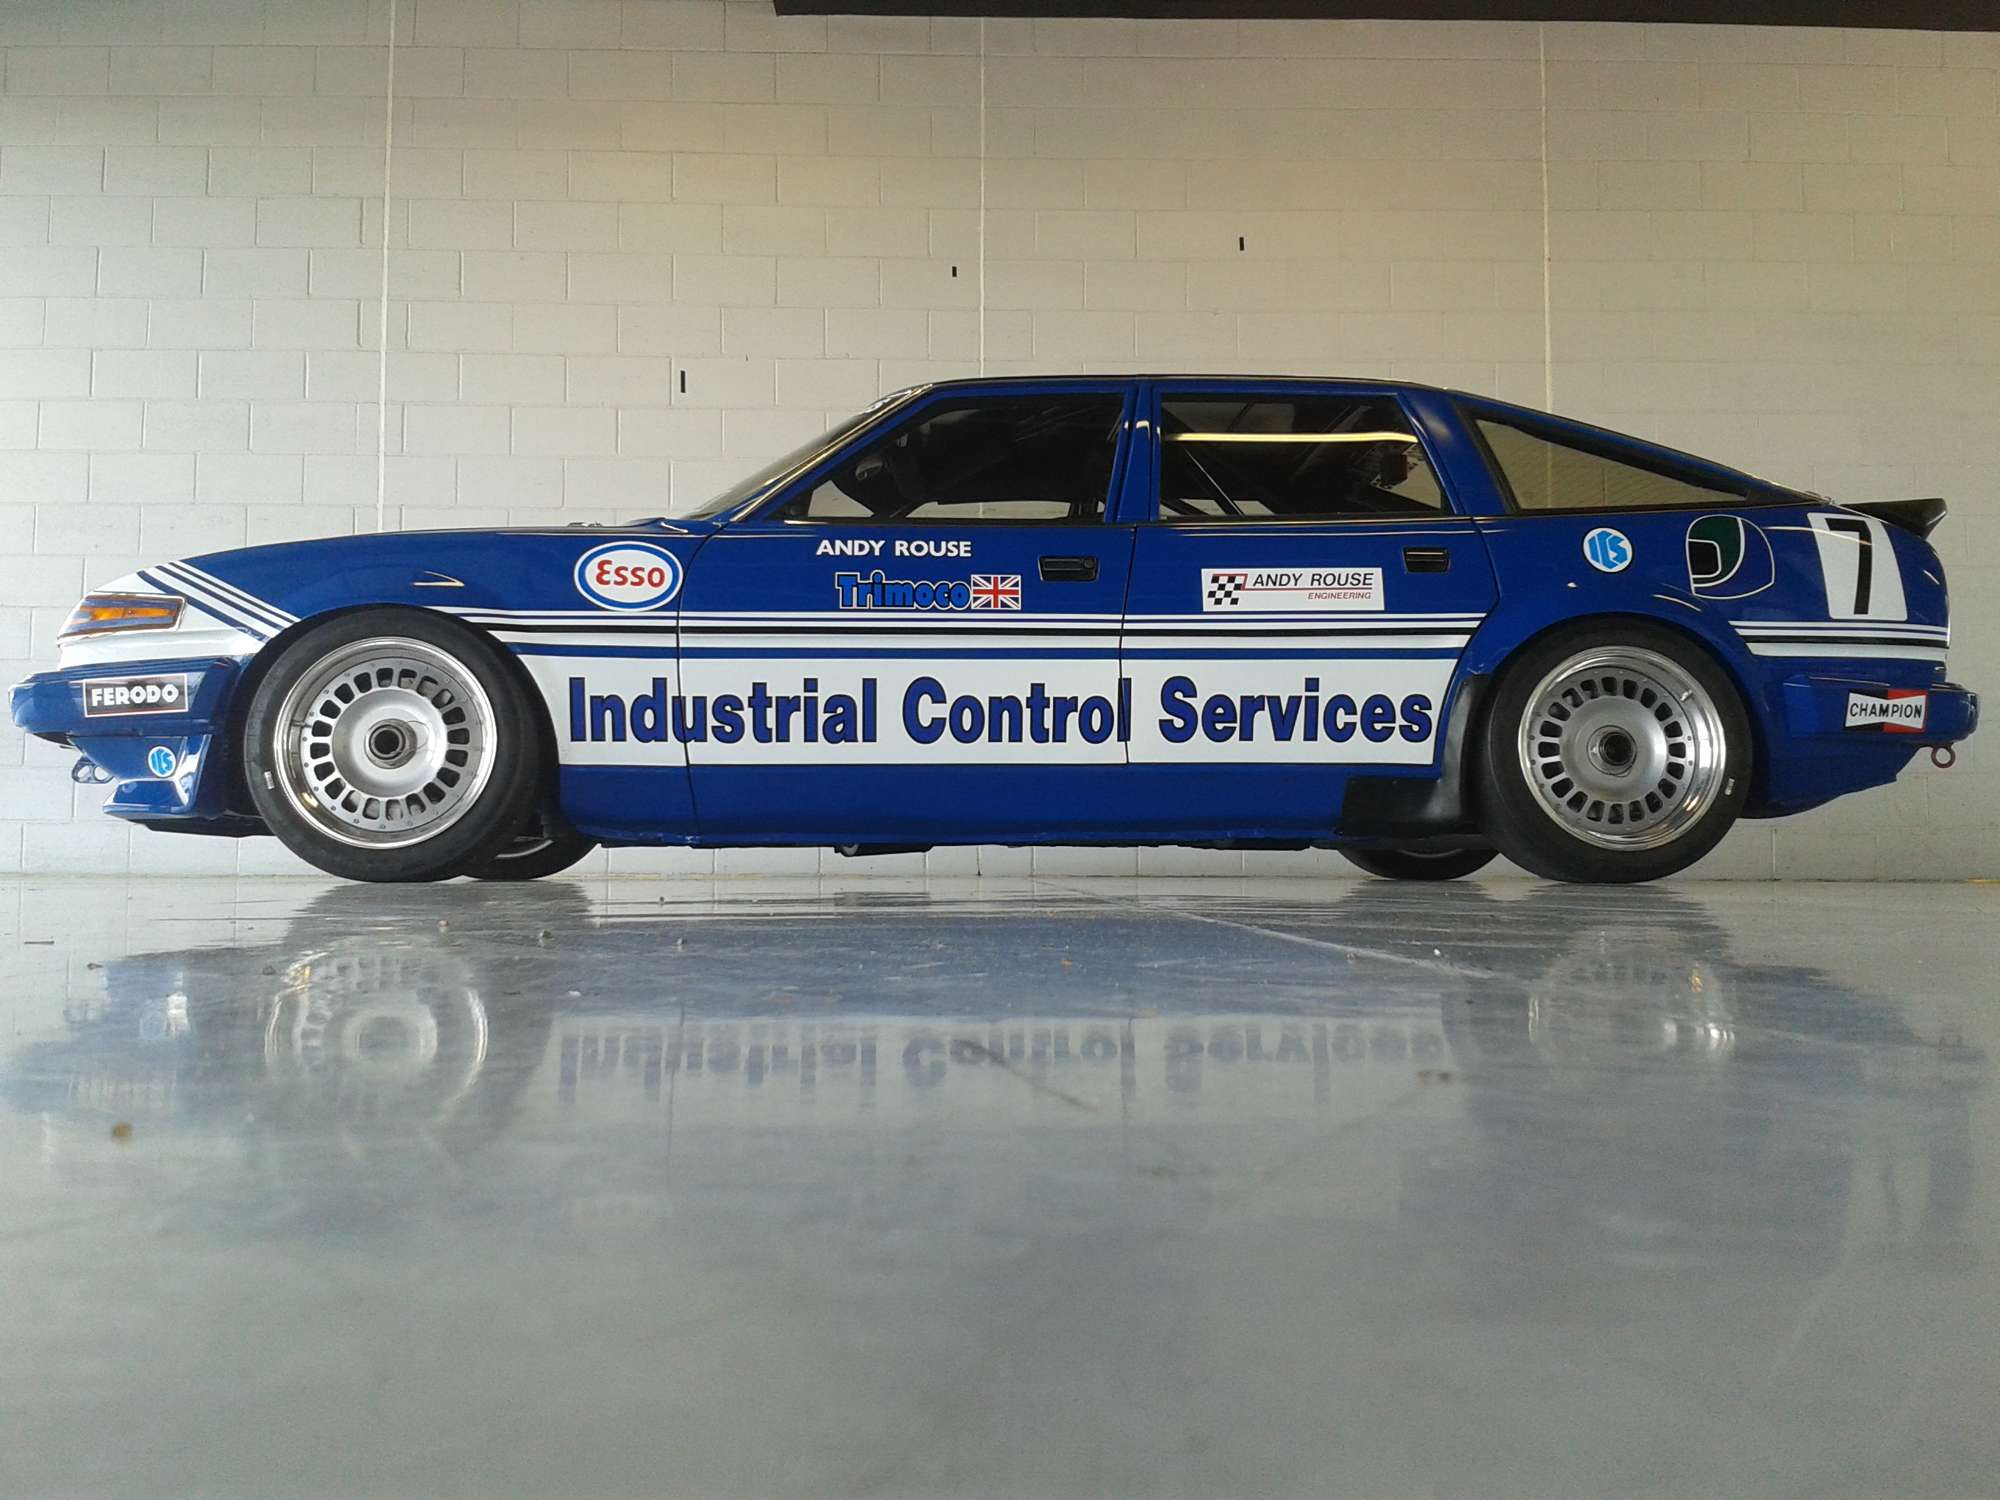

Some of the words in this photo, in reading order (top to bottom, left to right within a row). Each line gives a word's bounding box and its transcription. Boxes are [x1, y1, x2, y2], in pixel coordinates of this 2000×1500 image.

[816, 539, 886, 556] ANDY
[895, 540, 972, 557] ROUSE
[595, 559, 666, 588] Esso
[1825, 517, 1873, 615] 7
[835, 569, 971, 610] Trimoco
[1252, 573, 1303, 587] ANDY
[1310, 573, 1374, 587] ROUSE
[1307, 592, 1372, 600] ENGINEERING
[91, 684, 179, 707] FERODO
[569, 677, 878, 744] Industrial
[902, 676, 1132, 745] Control
[1159, 675, 1433, 743] Services
[1850, 703, 1922, 718] CHAMPION
